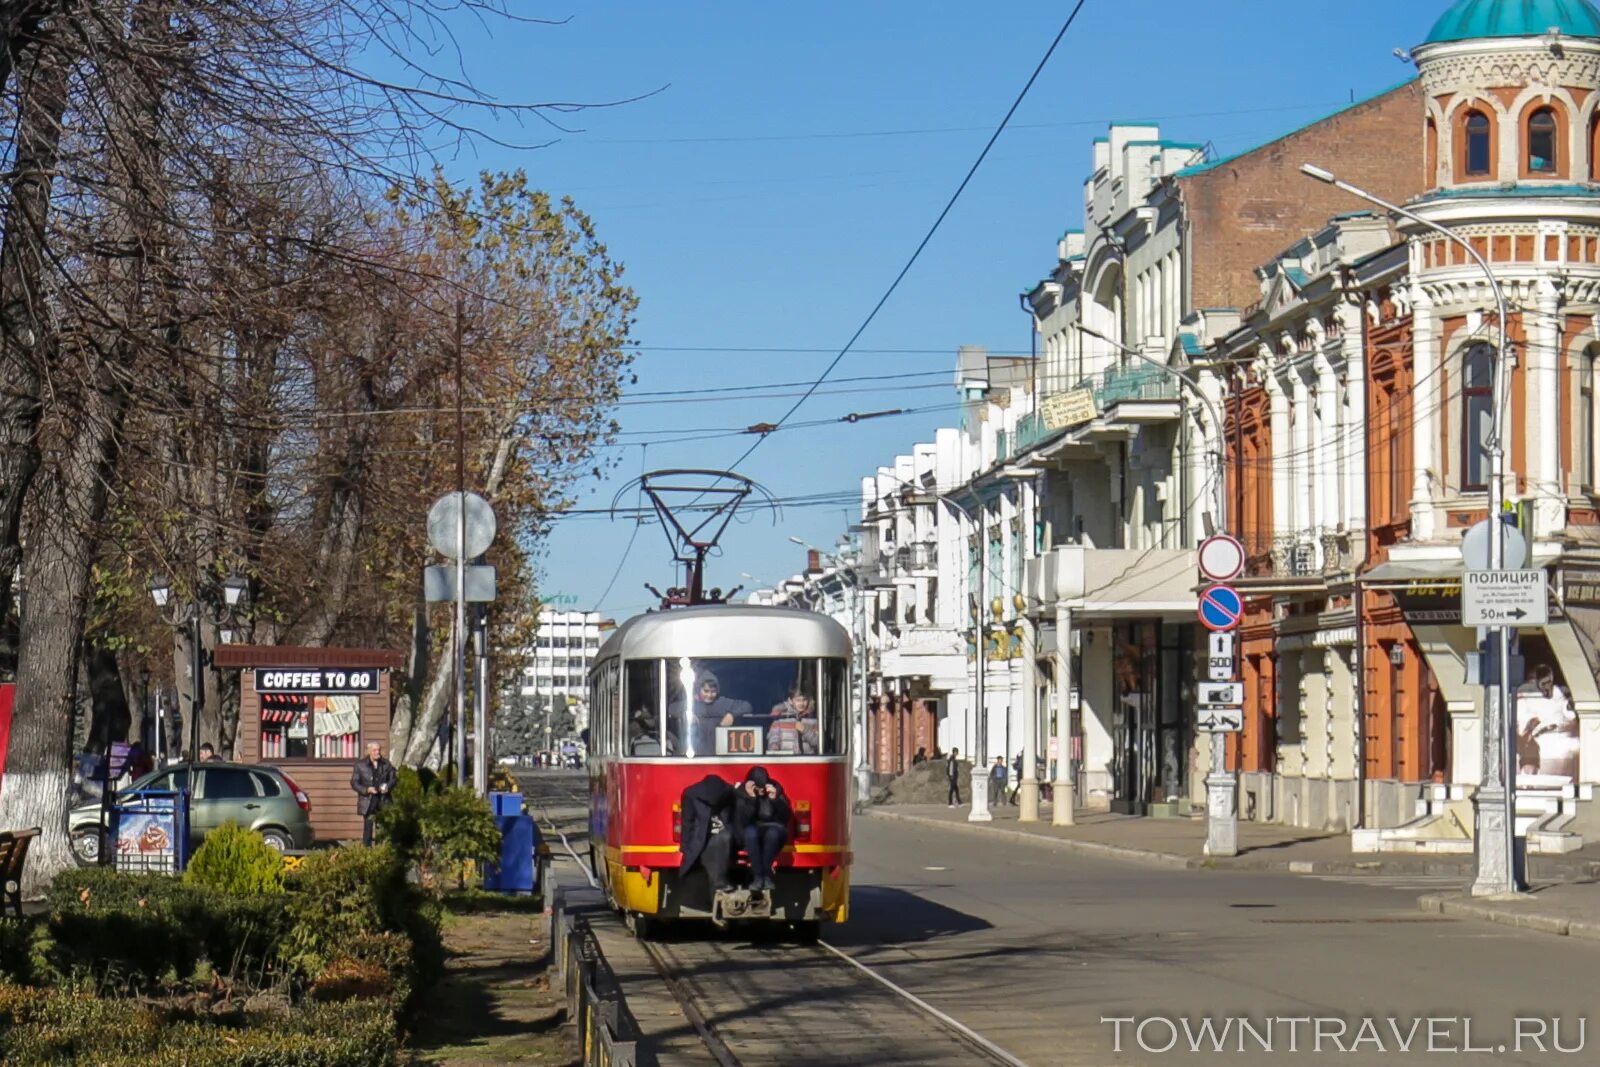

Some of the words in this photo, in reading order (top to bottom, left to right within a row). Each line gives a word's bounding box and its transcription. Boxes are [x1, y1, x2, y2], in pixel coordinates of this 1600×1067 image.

[1469, 572, 1539, 584] ПОЛИЦИЯ
[1481, 608, 1505, 619] 50м
[1210, 657, 1232, 668] 500
[263, 672, 321, 688] COFFEE
[325, 673, 346, 688] TO
[349, 673, 370, 688] GO
[729, 731, 755, 752] 10
